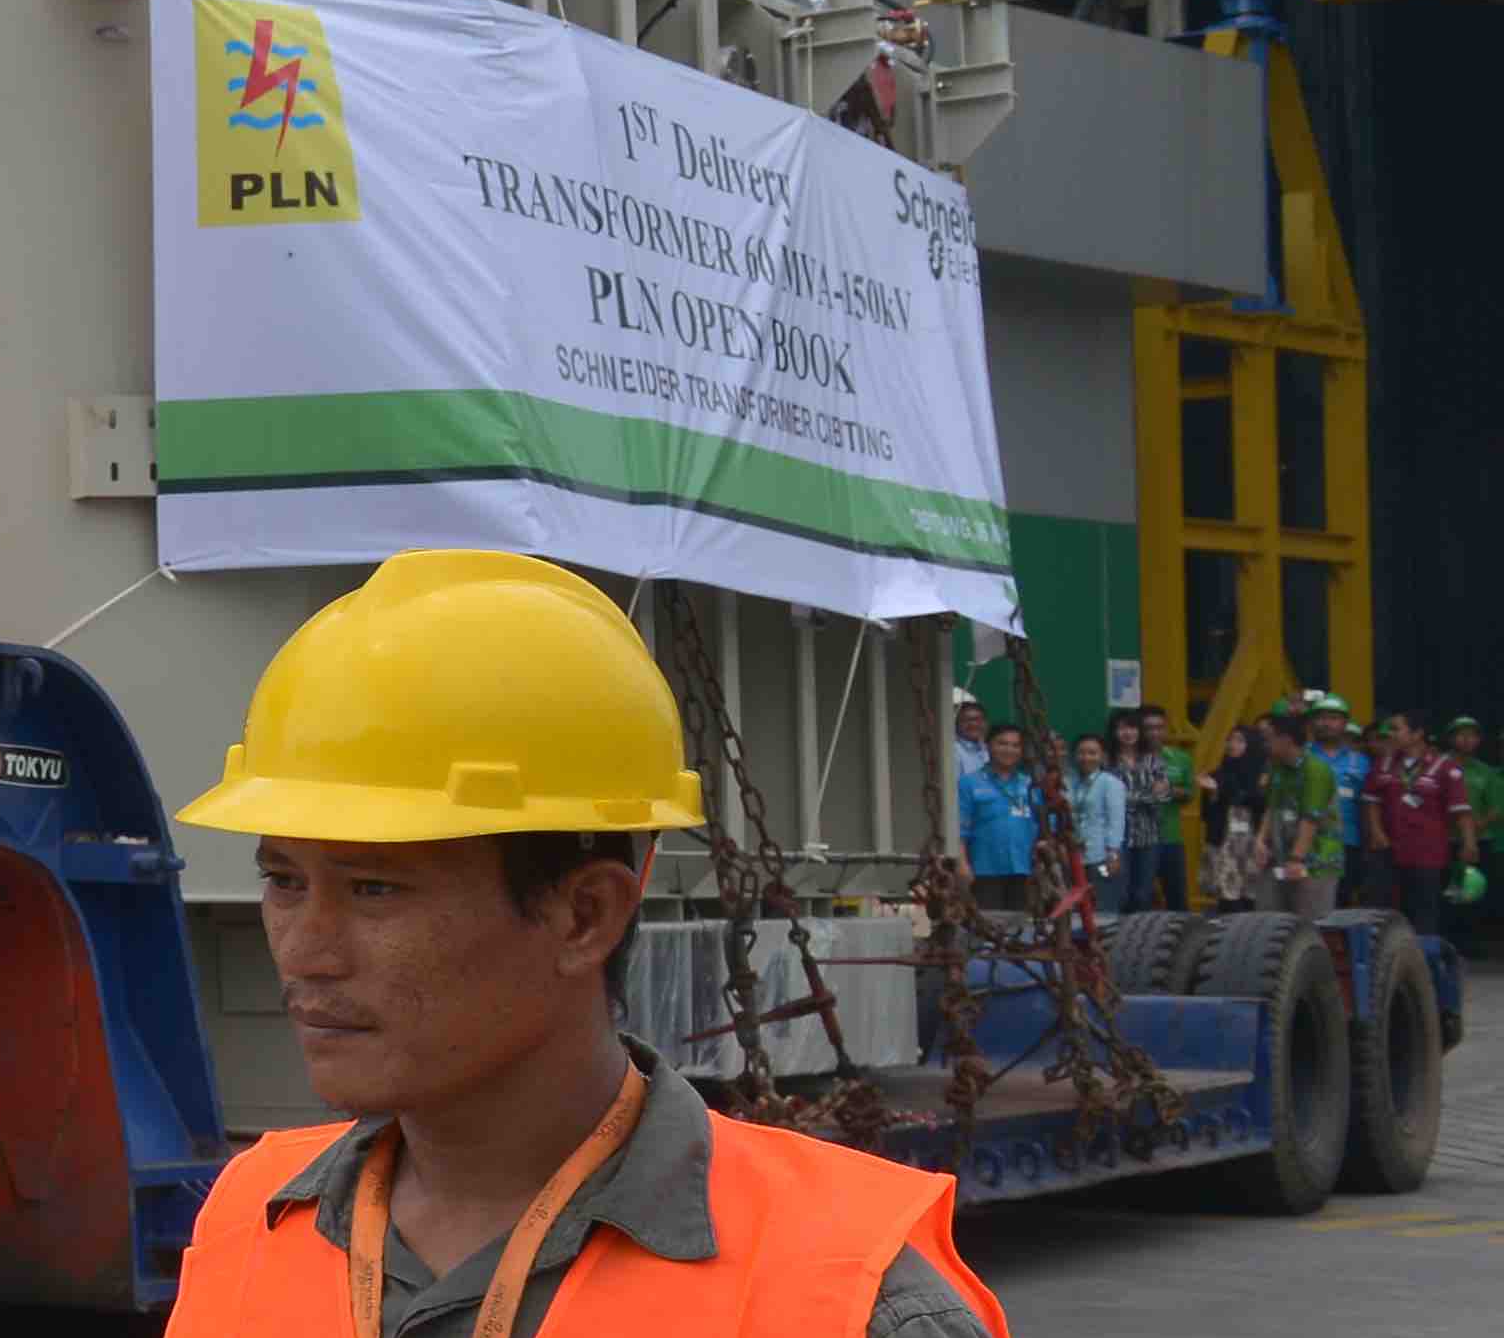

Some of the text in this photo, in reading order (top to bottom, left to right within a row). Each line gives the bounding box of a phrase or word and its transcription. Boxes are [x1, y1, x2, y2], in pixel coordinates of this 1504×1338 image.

[231, 170, 339, 211] PLN
[463, 154, 740, 277] TRANSFORMER
[744, 235, 776, 286] 60
[670, 121, 791, 228] Delivery
[584, 265, 856, 394] PLN OPEN BOOK
[555, 343, 685, 403] SCHNEIDER
[684, 372, 815, 440] TRANSFORMER
[4, 752, 62, 781] TOKYU
